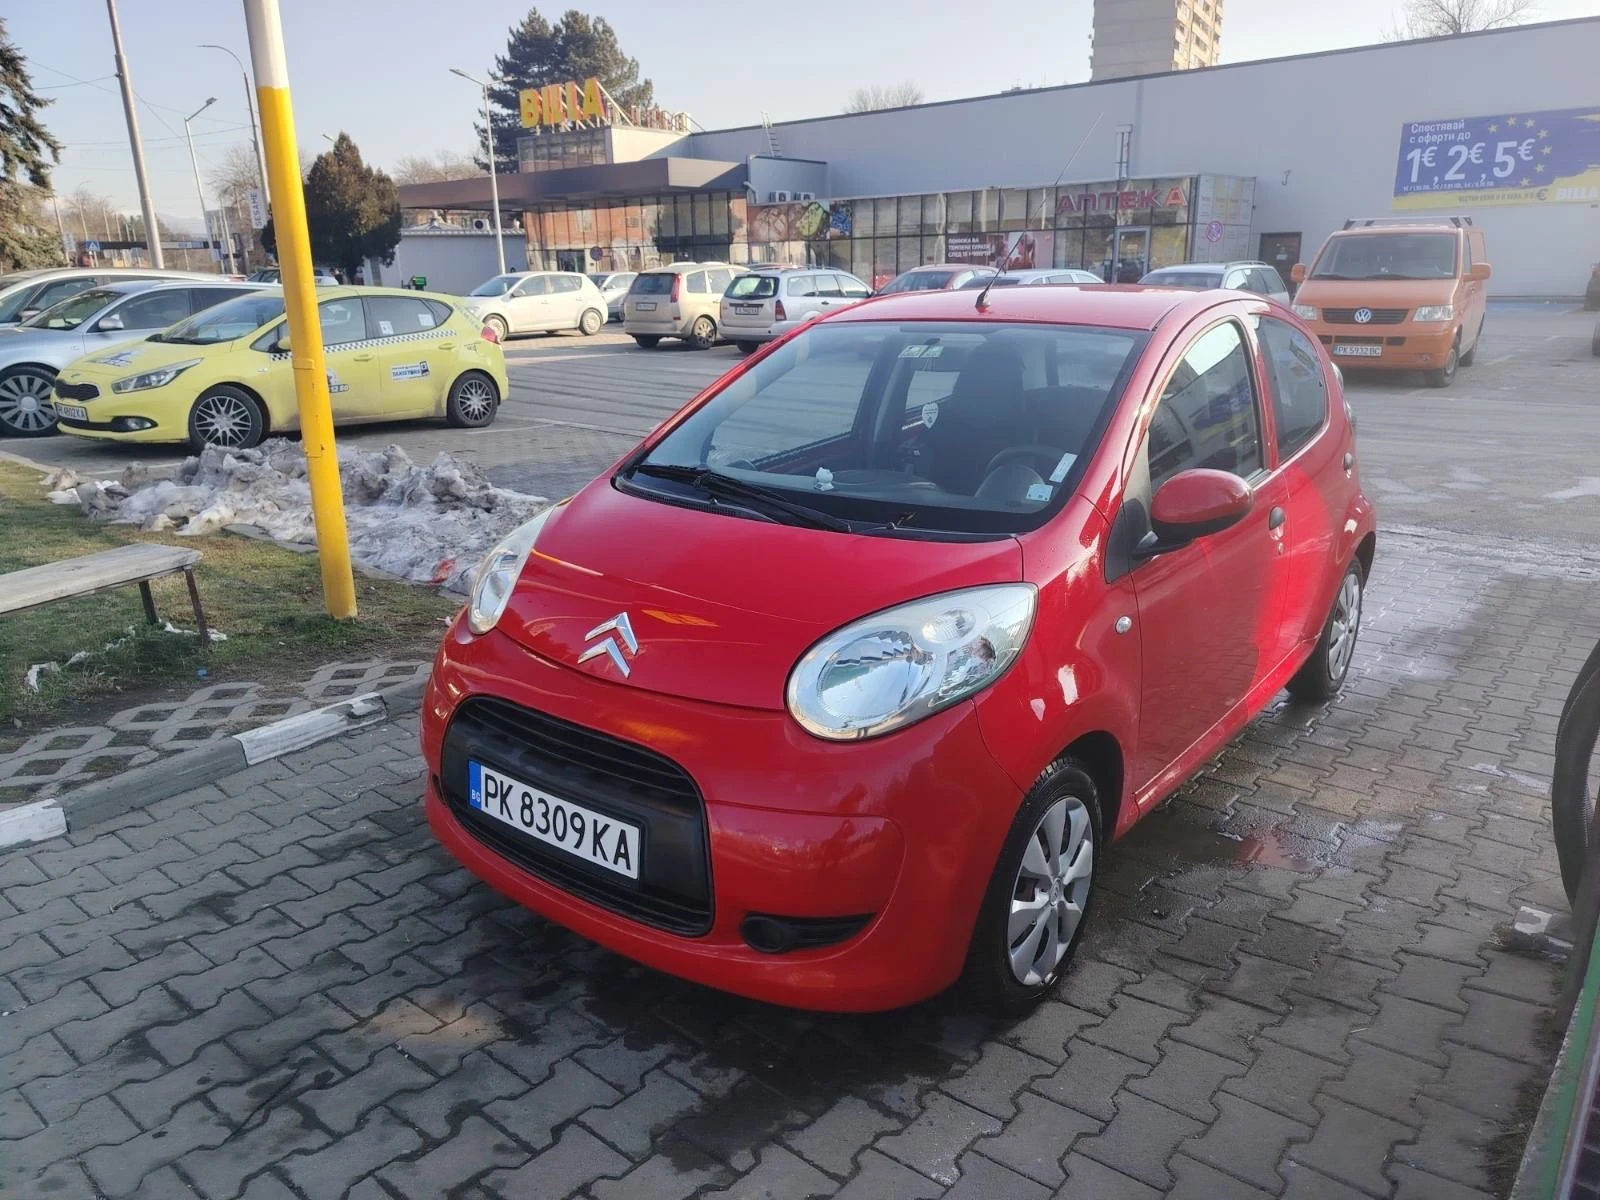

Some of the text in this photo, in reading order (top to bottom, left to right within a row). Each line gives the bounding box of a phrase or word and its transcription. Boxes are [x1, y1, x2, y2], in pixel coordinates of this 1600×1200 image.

[519, 77, 606, 129] BILLA
[1411, 119, 1465, 134] Спестявай
[1418, 133, 1456, 145] оферти
[1457, 131, 1472, 142] до
[1057, 186, 1188, 213] АПТЕКА
[471, 788, 481, 802] BG
[484, 773, 631, 870] PK 8309 KA
